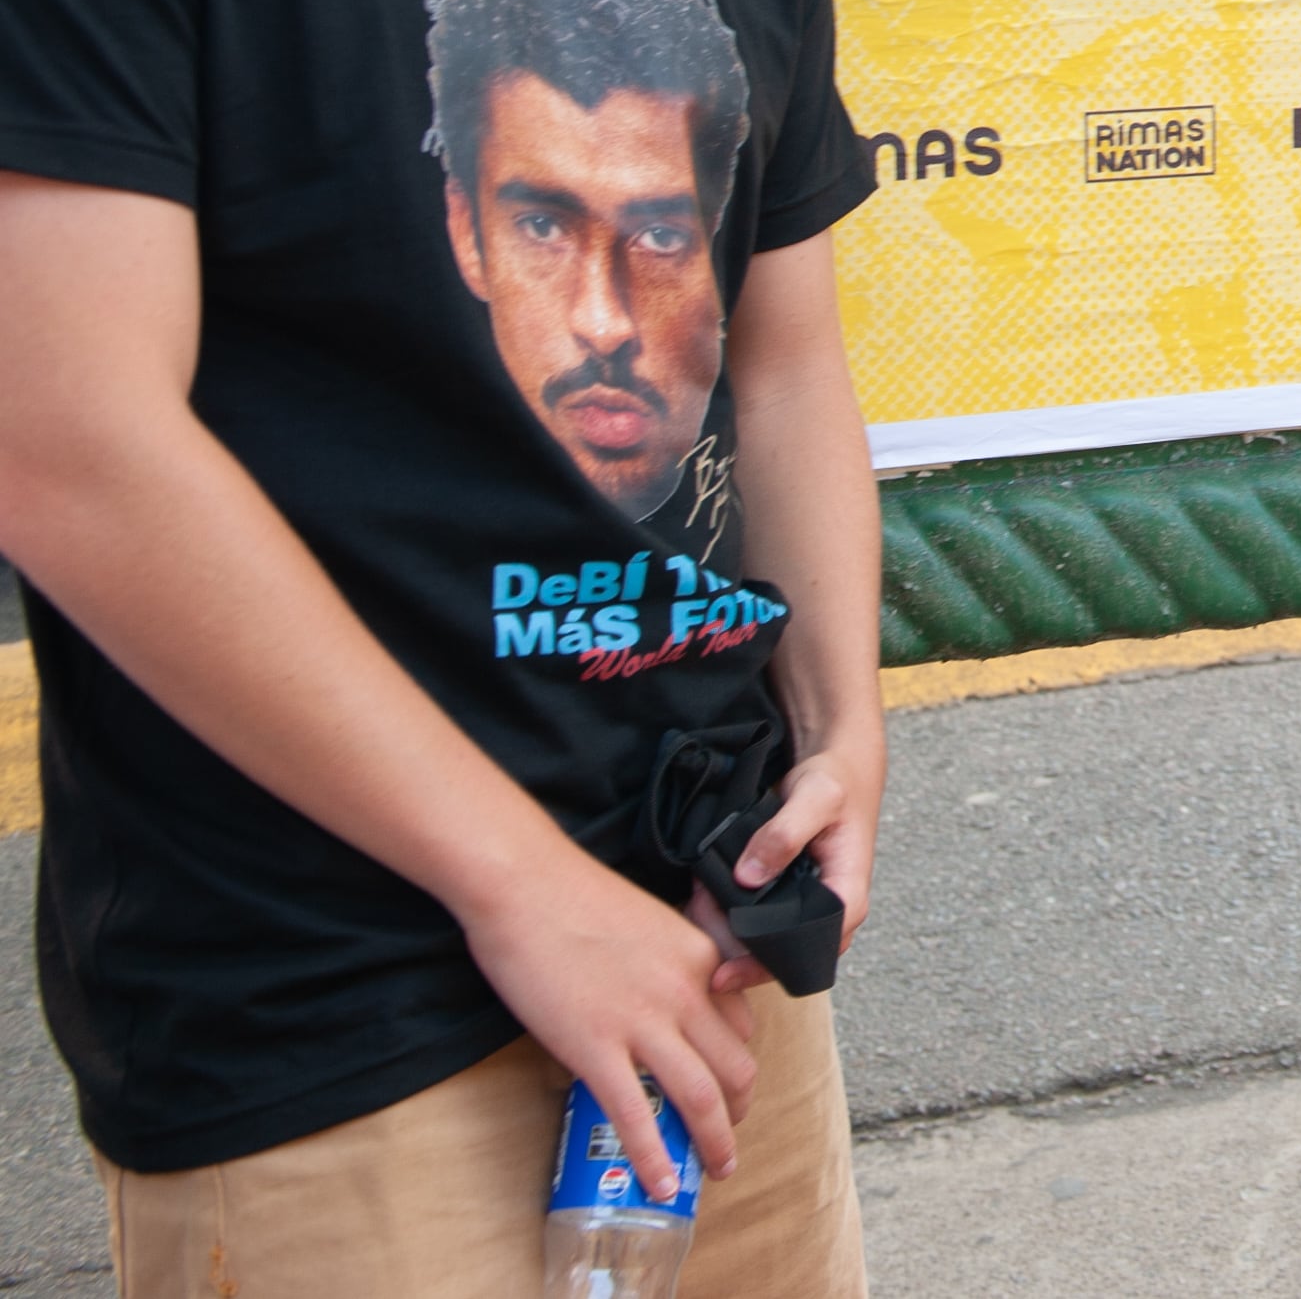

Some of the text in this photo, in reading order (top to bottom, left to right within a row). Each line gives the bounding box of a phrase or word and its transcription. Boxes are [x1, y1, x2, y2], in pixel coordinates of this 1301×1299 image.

[1096, 146, 1206, 173] NATION
[577, 619, 759, 682] World Tour
